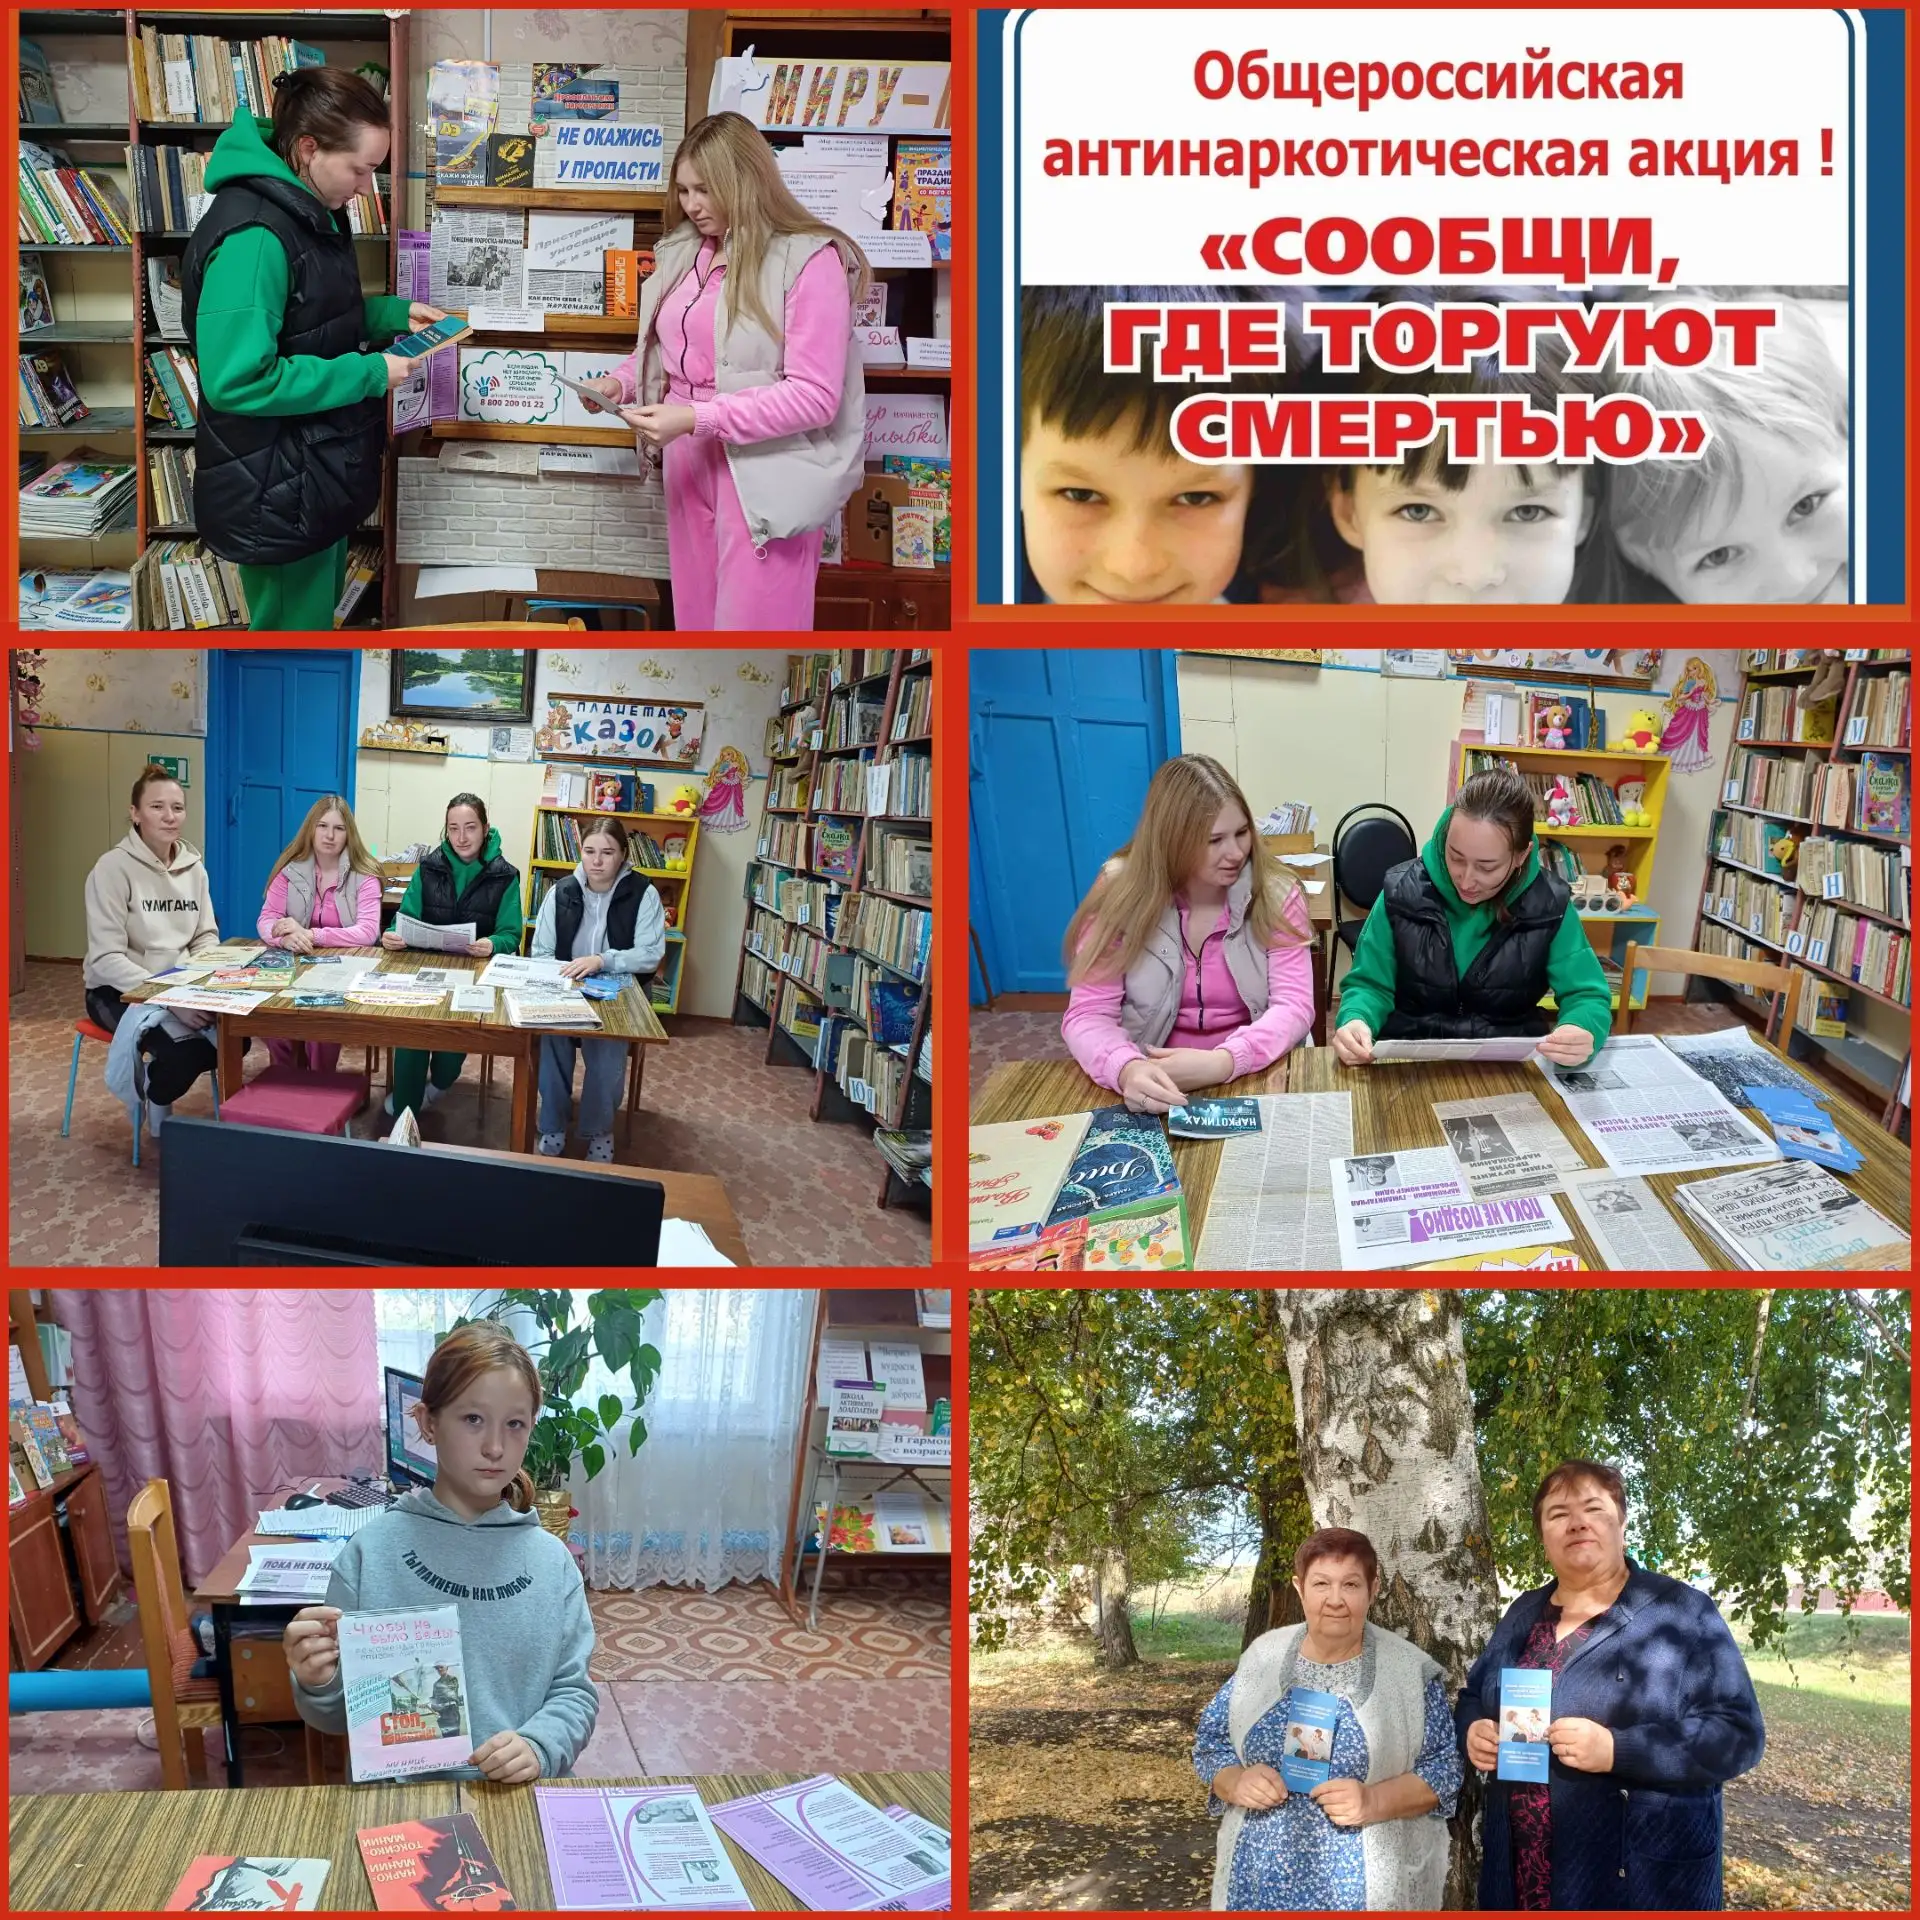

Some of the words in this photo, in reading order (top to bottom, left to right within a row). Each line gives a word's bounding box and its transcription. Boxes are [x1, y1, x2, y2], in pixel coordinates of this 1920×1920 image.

[1194, 49, 1684, 110] Общероссийская
[556, 126, 581, 146] НЕ
[583, 127, 662, 147] ОКАЖИСЬ
[1043, 138, 1602, 188] антинаркотическая
[1629, 138, 1799, 184] акция
[1820, 128, 1835, 176] !
[557, 160, 570, 180] У
[573, 160, 661, 181] ПРОПАСТИ
[1200, 217, 1679, 284] «СООБЩИ,
[1110, 309, 1278, 374] ГДЕ
[1309, 309, 1775, 367] ТОРГУЮТ
[1177, 400, 1705, 459] СМЕРТЬЮ»
[1741, 719, 1753, 739] В
[1849, 719, 1865, 744] М
[1825, 874, 1840, 897] Н
[799, 906, 809, 922] Н
[1720, 899, 1732, 919] Ж
[1751, 914, 1761, 933] З
[1788, 933, 1802, 954] О
[1811, 940, 1824, 962] П
[851, 1080, 865, 1101] Ю
[1185, 1114, 1256, 1127] НАРКОТИКАХ
[1470, 1167, 1517, 1180] ДРУЖИТЬ
[1489, 1160, 1529, 1173] ПРОТИВ
[1521, 1163, 1554, 1174] БУДЕМ
[1482, 1202, 1502, 1227] НЕ
[1503, 1197, 1545, 1223] ПОКА
[1408, 1204, 1482, 1243] ПОЗДНО!
[840, 1393, 864, 1401] ШКОЛА
[837, 1406, 879, 1415] ДОЛГОЛЕТИЯ
[894, 1435, 903, 1444] В
[263, 1560, 291, 1569] ПОКА
[293, 1562, 306, 1570] НЕ
[402, 1550, 422, 1569] ТЫ
[416, 1567, 470, 1598] ПАХНЕШЬ
[472, 1587, 495, 1602] КАК
[362, 1833, 405, 1847] МАНИИ
[365, 1841, 423, 1857] ТОКСИКО-
[370, 1858, 416, 1873] МАНИИ
[373, 1868, 416, 1882] НАРКО-
